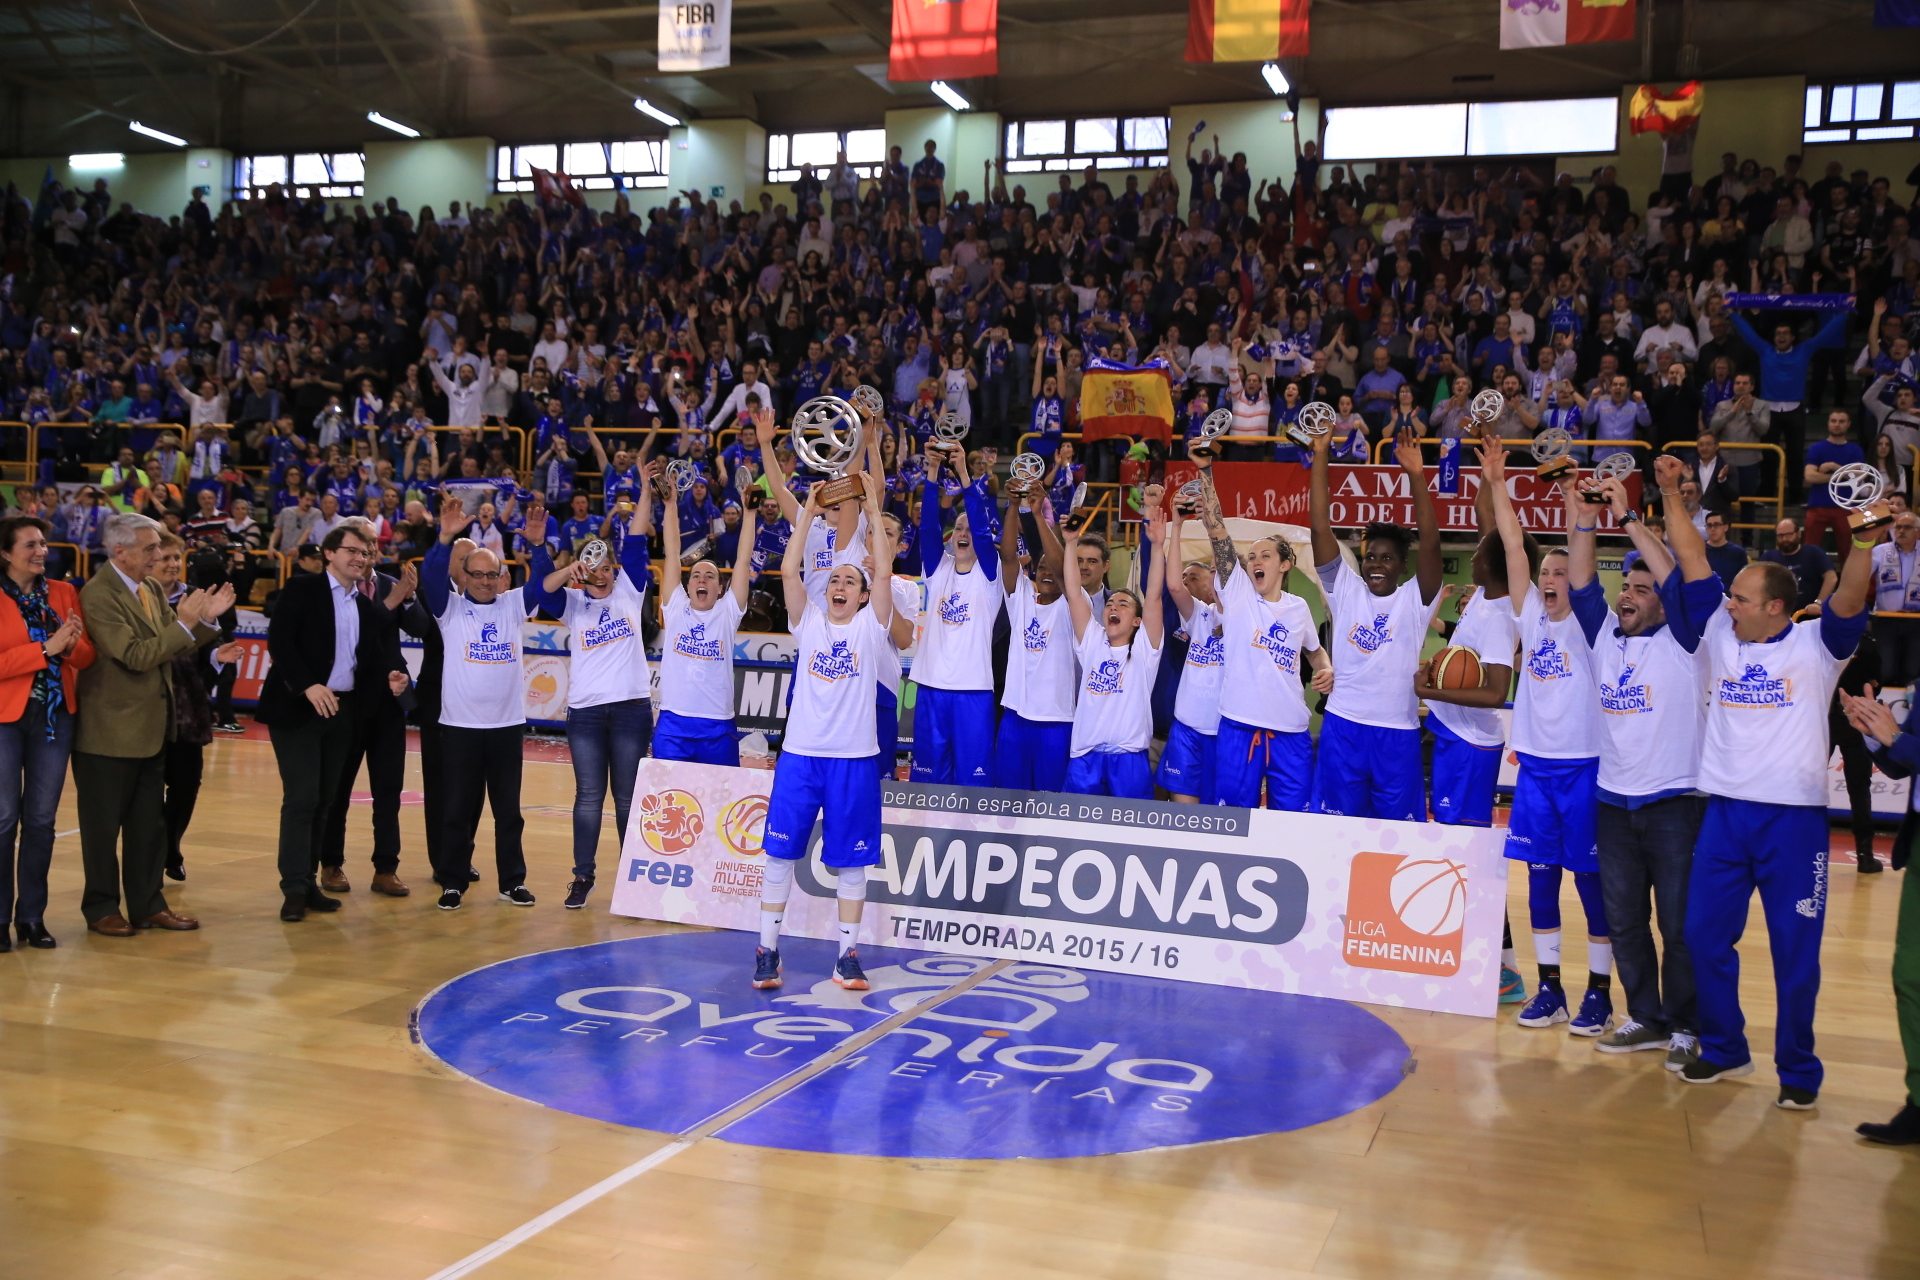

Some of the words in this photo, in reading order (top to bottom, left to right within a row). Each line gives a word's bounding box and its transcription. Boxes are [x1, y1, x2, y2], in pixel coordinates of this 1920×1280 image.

[677, 3, 715, 24] FIBA
[677, 26, 712, 38] EUROPE
[1236, 491, 1257, 518] La
[1356, 503, 1394, 524] DE
[1403, 504, 1417, 525] L
[1597, 561, 1622, 570] SALIDA
[586, 626, 631, 647] PABELLON
[680, 634, 719, 648] RETUMBE
[470, 642, 511, 652] RETUMBE
[676, 643, 720, 657] PABELLON
[470, 651, 512, 661] PABELLON
[1722, 679, 1784, 691] RETUMBE
[1720, 690, 1785, 703] PABELLON
[713, 872, 763, 887] MUJER
[810, 832, 1279, 933] CAMPEONAS
[1808, 851, 1825, 913] avenida
[1348, 920, 1386, 937] LIGA
[891, 916, 1056, 954] TEMPORADA
[1064, 935, 1124, 962] 2015
[1152, 945, 1180, 969] 16
[1346, 938, 1456, 967] FEMENINA
[555, 986, 1213, 1092] avenida
